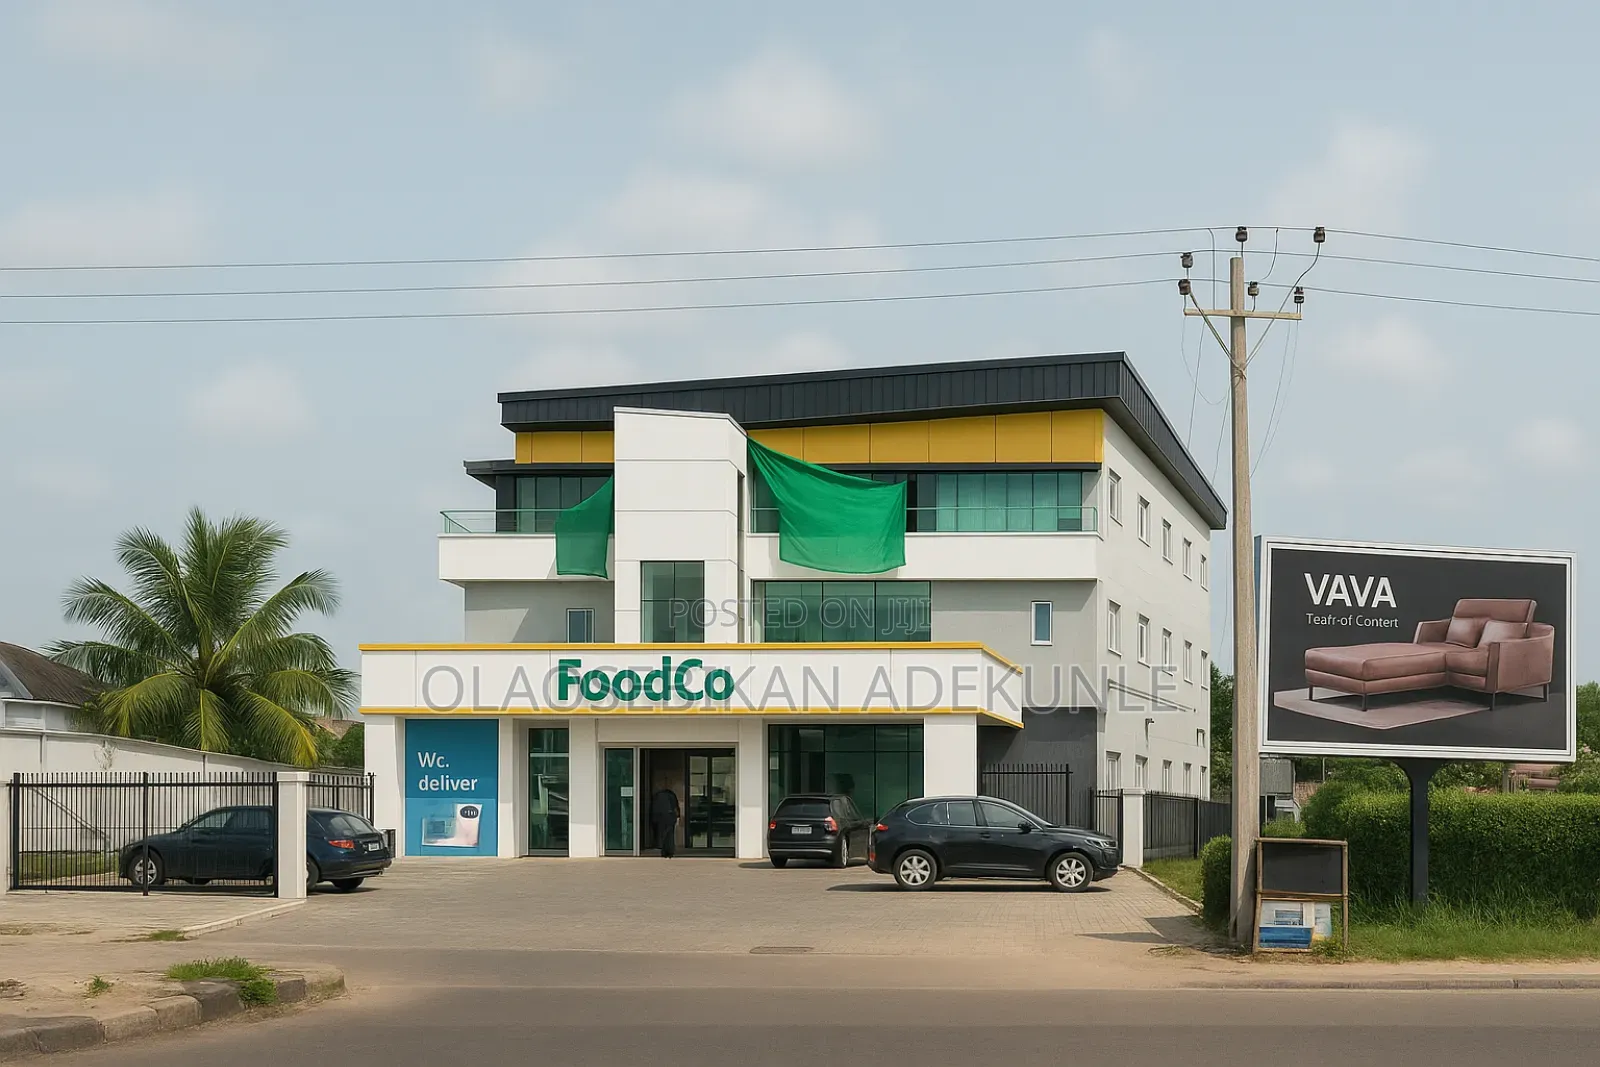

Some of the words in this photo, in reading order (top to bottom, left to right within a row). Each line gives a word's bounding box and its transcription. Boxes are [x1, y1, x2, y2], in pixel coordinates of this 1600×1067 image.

[1304, 573, 1397, 608] VAVA
[1355, 614, 1398, 628] Contert
[558, 656, 735, 701] FoodCo
[418, 775, 478, 791] deliver
